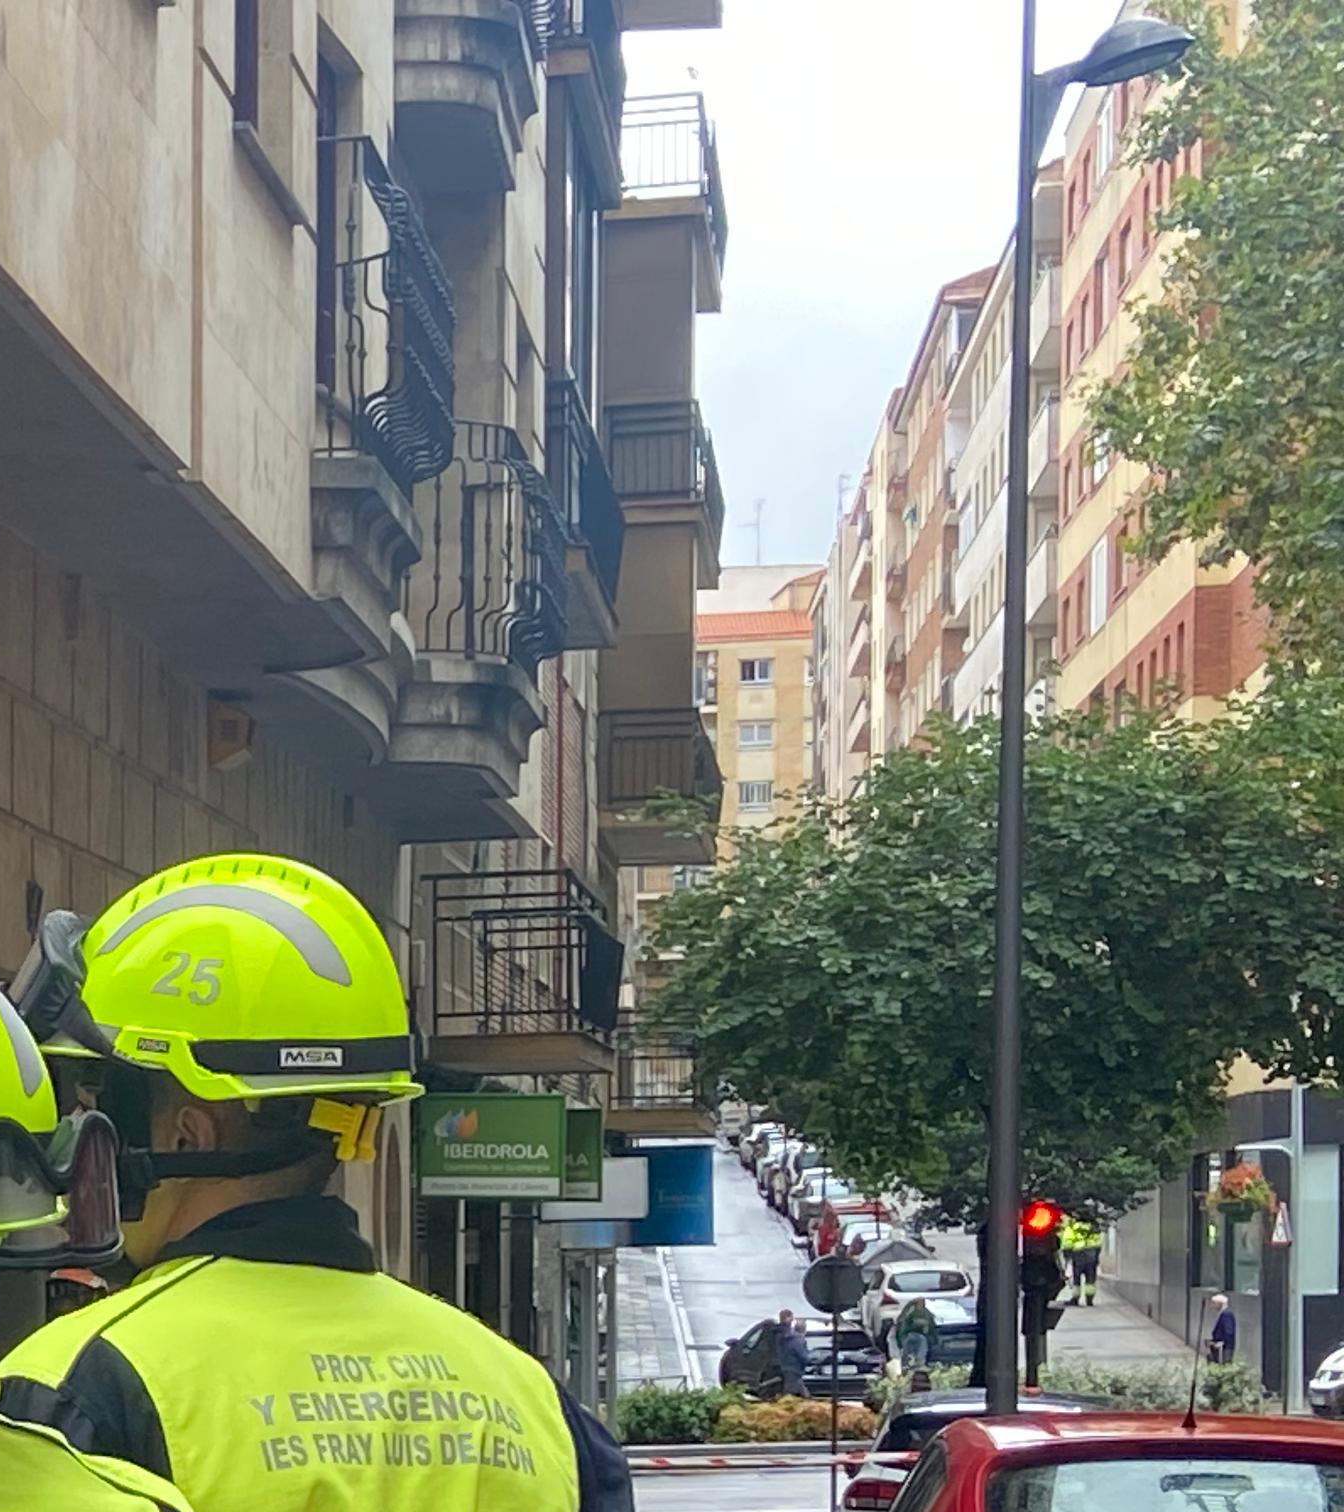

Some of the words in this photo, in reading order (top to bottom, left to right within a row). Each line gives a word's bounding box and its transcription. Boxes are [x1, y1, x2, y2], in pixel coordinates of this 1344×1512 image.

[151, 951, 224, 1006] 25
[284, 1050, 338, 1063] MSA
[443, 1143, 550, 1160] IBERDROLA
[309, 1352, 387, 1383] PROT.
[387, 1353, 459, 1382] CIVIL
[249, 1394, 275, 1427] Y
[287, 1389, 524, 1435] EMERGENCIAS
[260, 1434, 309, 1473] IES
[312, 1432, 374, 1466] FRAY
[381, 1431, 433, 1468] LUIS
[440, 1431, 477, 1467] DE
